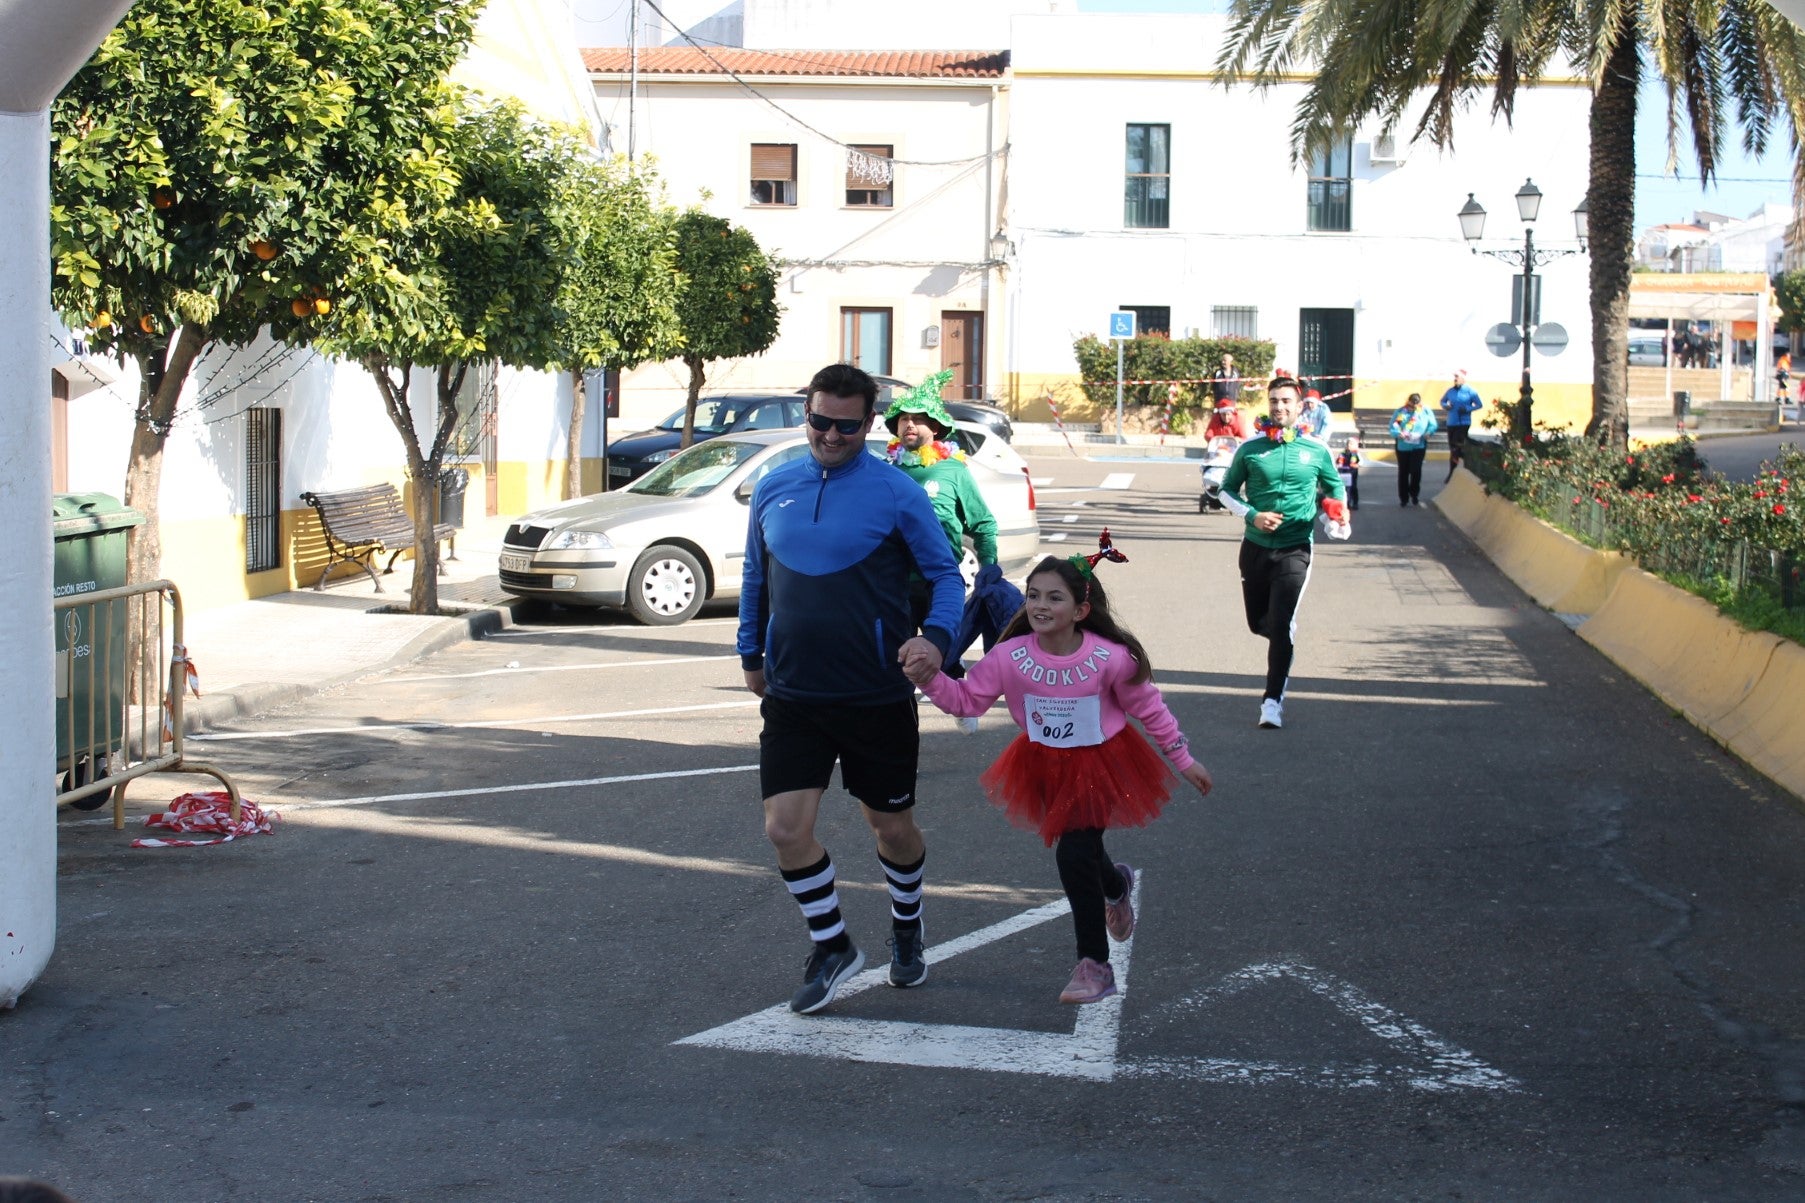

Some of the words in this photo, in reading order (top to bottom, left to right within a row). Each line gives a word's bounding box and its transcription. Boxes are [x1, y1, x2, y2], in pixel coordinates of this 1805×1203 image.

[76, 581, 96, 592] RESTO
[1009, 645, 1111, 686] BROOKLYN
[1043, 722, 1074, 739] 002
